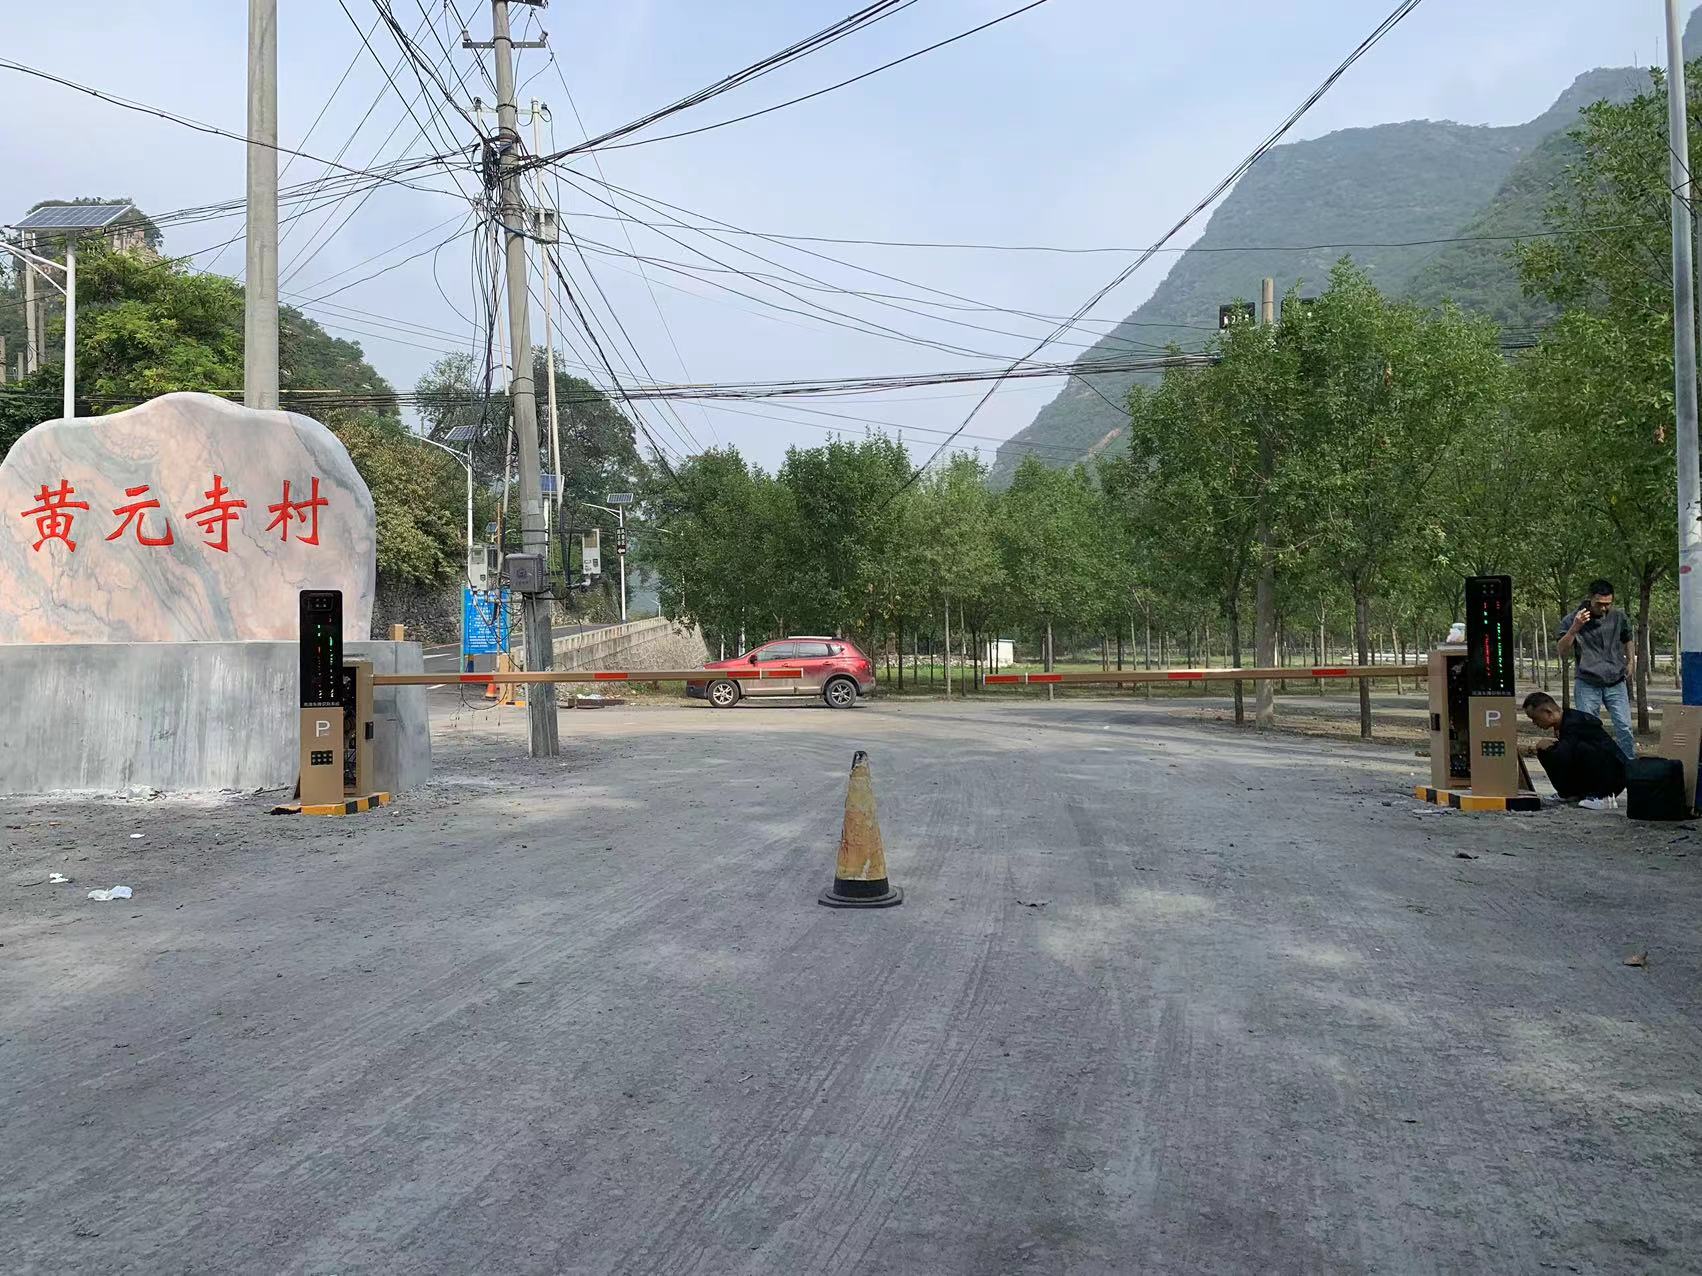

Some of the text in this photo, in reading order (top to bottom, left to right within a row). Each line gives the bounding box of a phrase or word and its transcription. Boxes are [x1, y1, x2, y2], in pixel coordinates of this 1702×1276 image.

[20, 474, 329, 552] 黄元寺村
[1486, 710, 1501, 728] P
[315, 720, 331, 738] P
